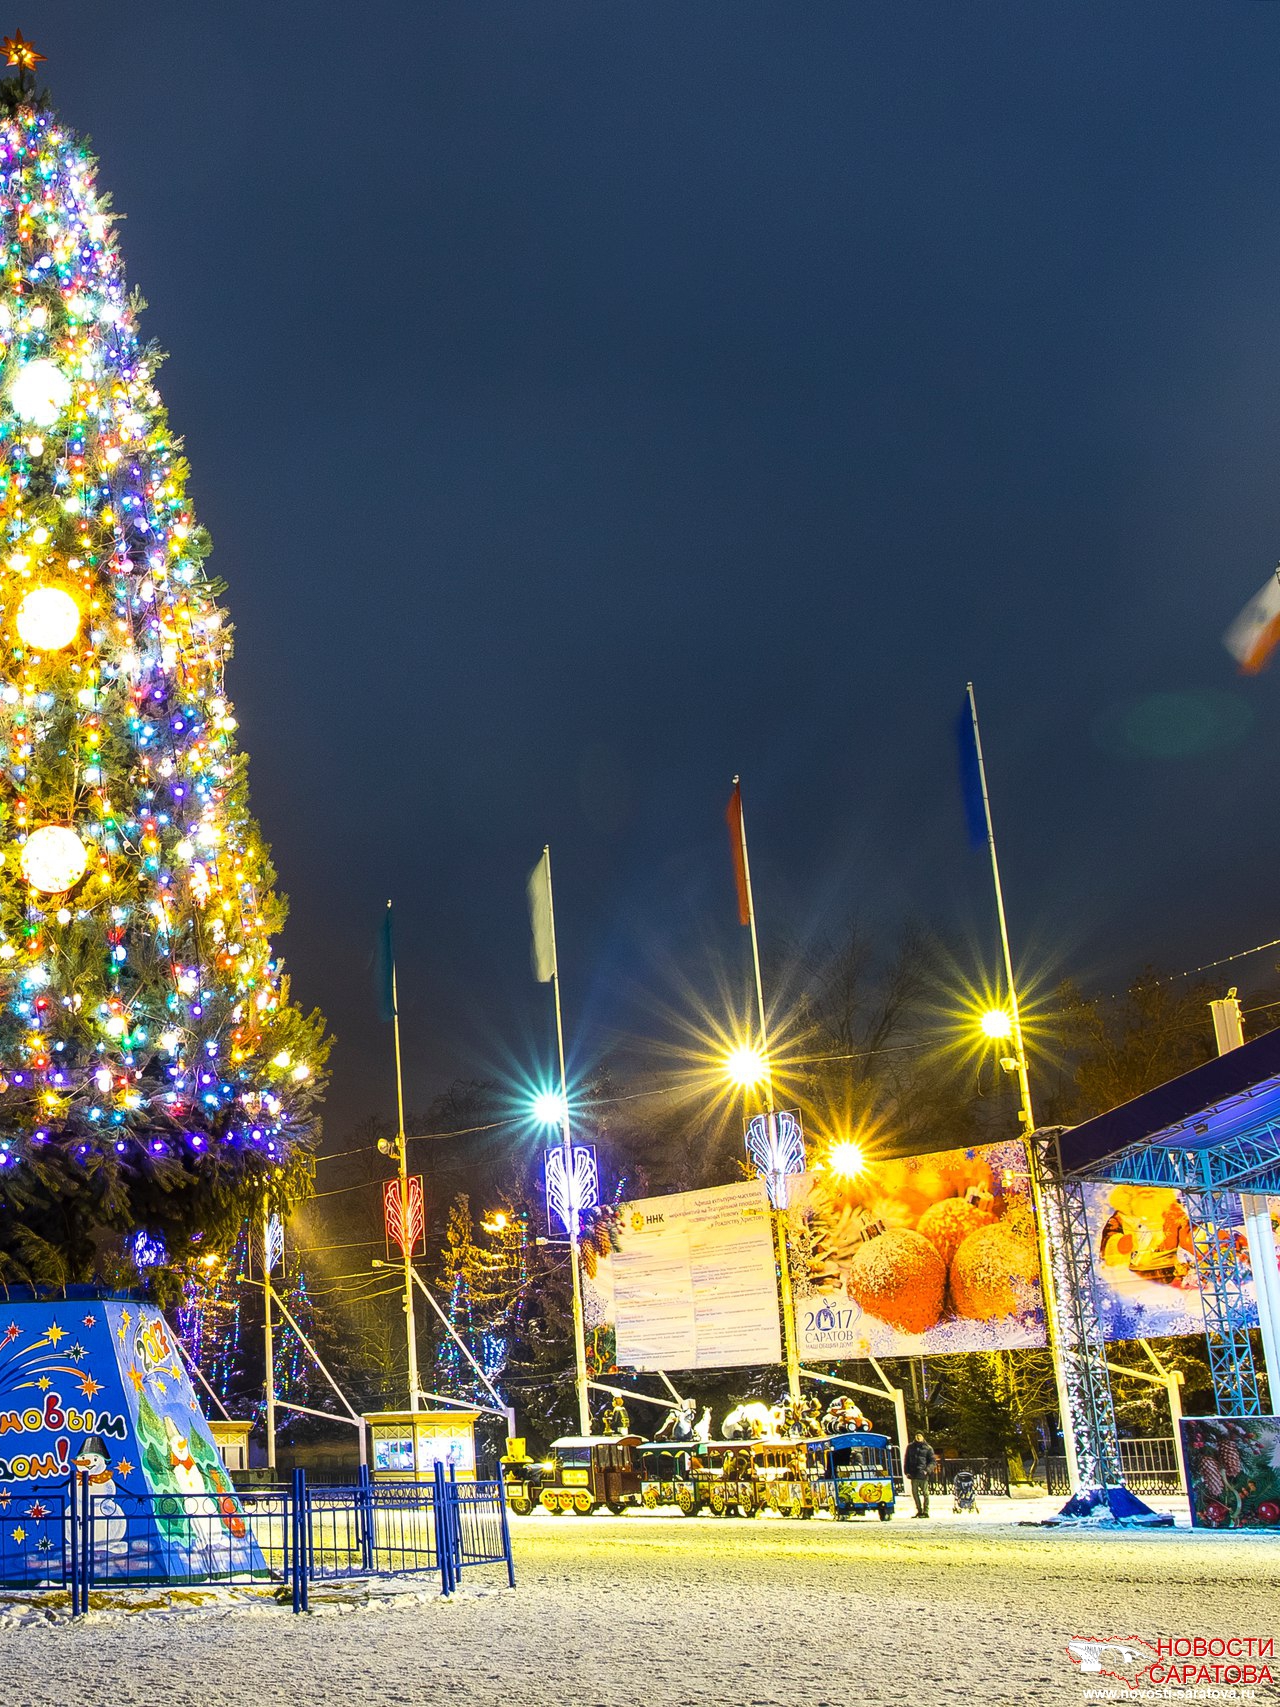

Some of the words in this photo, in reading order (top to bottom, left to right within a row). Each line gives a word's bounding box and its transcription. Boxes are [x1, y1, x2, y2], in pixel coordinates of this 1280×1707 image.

[645, 1213, 665, 1225] ННК
[804, 1309, 853, 1331] 2017
[135, 1317, 173, 1375] 2017
[805, 1330, 854, 1344] САРАТОВ
